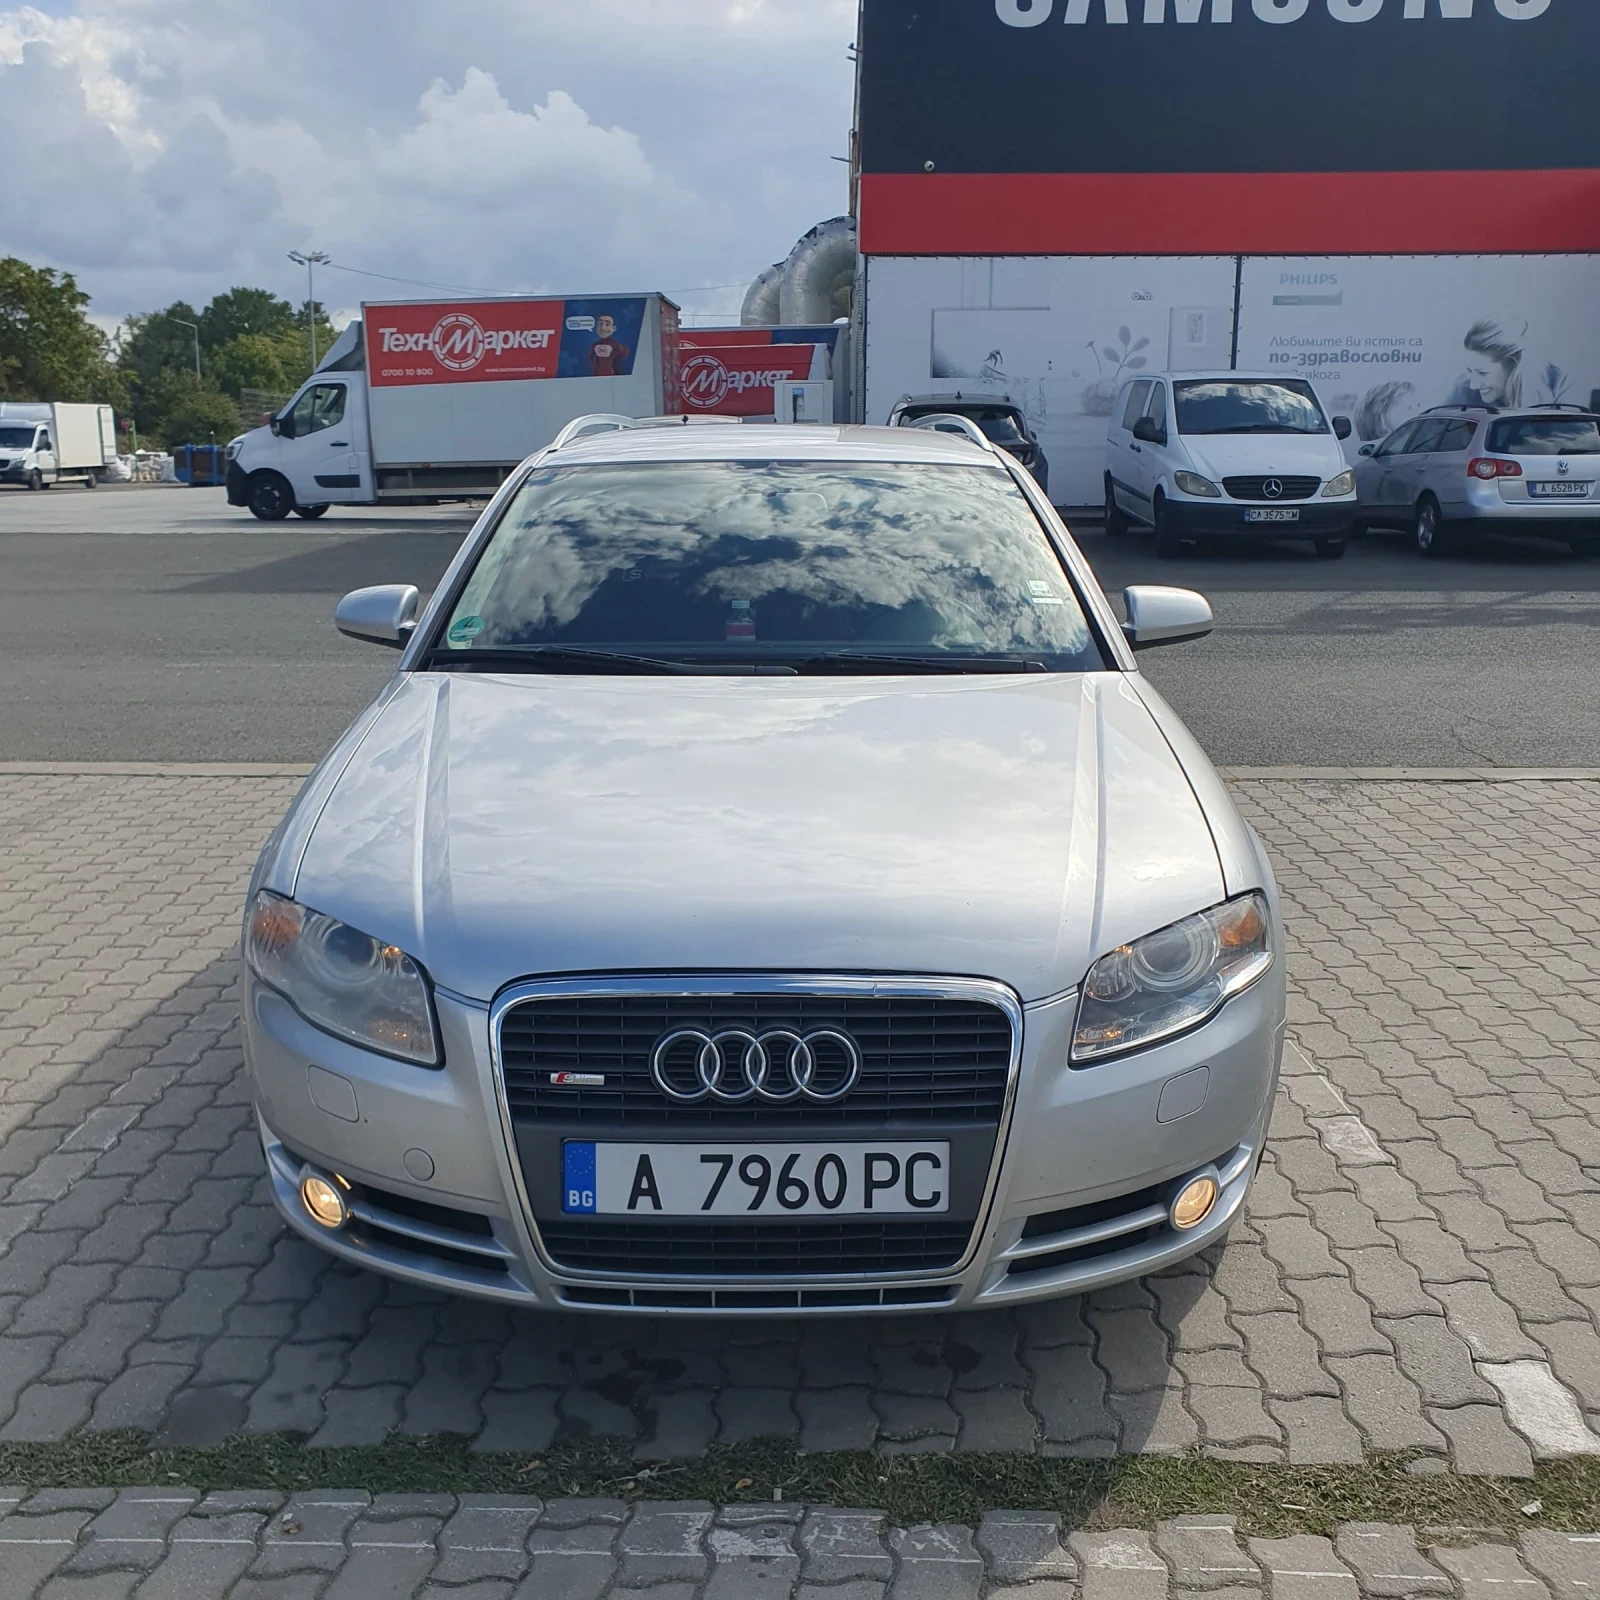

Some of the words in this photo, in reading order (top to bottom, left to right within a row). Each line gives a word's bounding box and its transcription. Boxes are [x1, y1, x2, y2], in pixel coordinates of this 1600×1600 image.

[1279, 272, 1338, 285] PHILIPS
[1269, 336, 1343, 347] Любимите
[1345, 335, 1361, 347] ви
[1364, 337, 1405, 347] ястия
[1408, 337, 1423, 346] са
[1268, 348, 1422, 366] по-здравословни
[405, 368, 415, 376] 10
[1551, 483, 1573, 493] 6528
[626, 1153, 663, 1210] A
[699, 1153, 847, 1210] 7960
[863, 1152, 942, 1209] PC
[568, 1190, 594, 1207] BG
